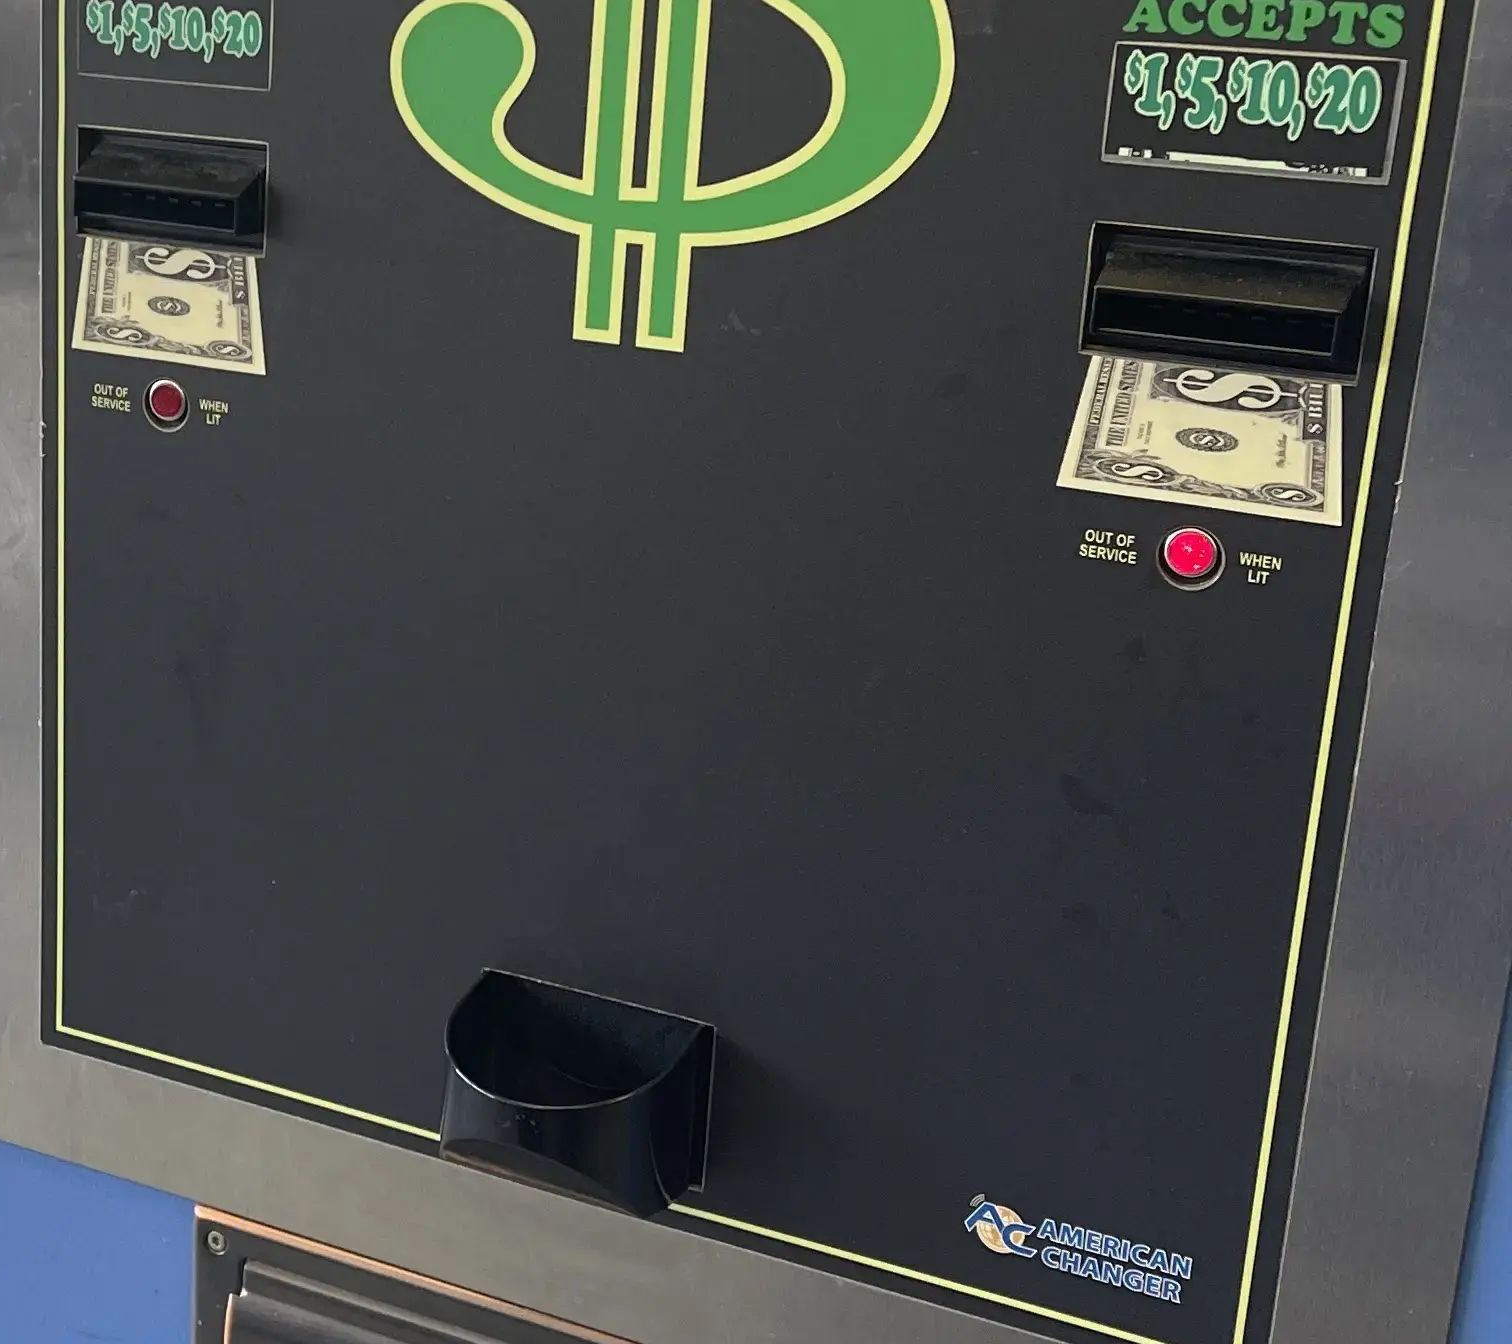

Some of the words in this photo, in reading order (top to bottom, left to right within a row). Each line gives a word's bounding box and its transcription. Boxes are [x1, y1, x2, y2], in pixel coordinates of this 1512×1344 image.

[94, 384, 113, 395] OUT
[116, 387, 128, 397] OF
[92, 396, 131, 412] SERVICE
[199, 399, 228, 413] WHEN
[206, 414, 221, 425] LIT
[1085, 529, 1113, 545] OUT
[1117, 534, 1135, 548] OF
[1079, 544, 1137, 565] SERVICE
[1240, 552, 1282, 570] WHEN
[1248, 571, 1269, 584] LIT
[1037, 1219, 1193, 1279] AMERICAN
[1041, 1247, 1182, 1303] CHANGER
